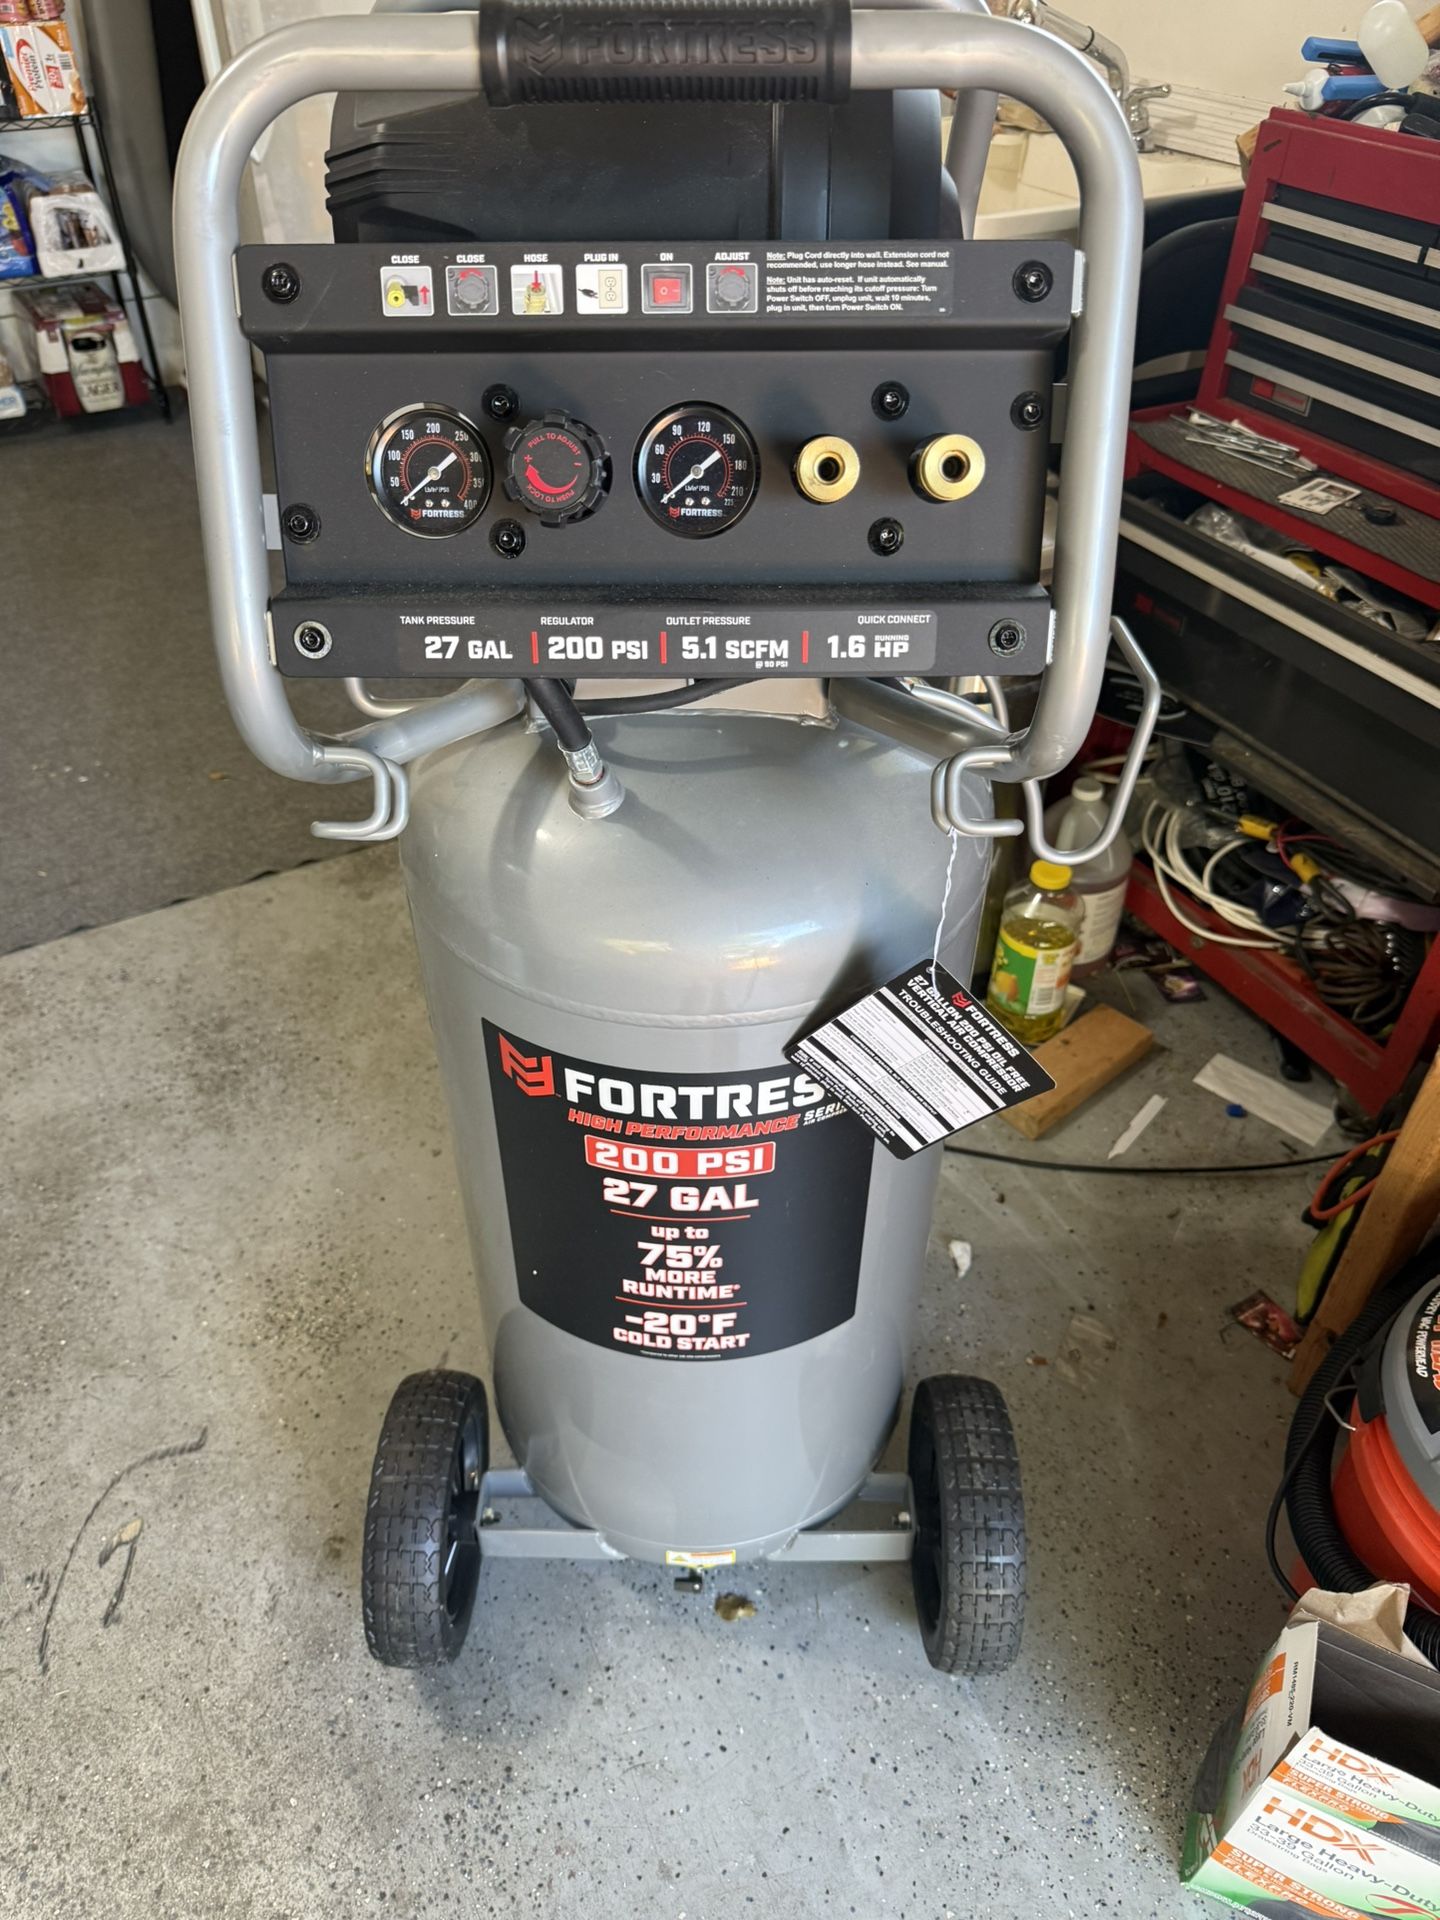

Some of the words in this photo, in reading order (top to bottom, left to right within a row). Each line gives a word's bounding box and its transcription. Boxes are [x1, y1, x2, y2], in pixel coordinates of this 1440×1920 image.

[572, 20, 816, 65] FORTRESS
[20, 51, 37, 92] Premier
[29, 55, 44, 89] Protein
[390, 255, 420, 264] CLOSE
[456, 254, 485, 263] CLOSE
[524, 254, 548, 262] HOSE
[584, 253, 607, 262] PLUG
[608, 253, 619, 262] IN
[660, 253, 673, 261] ON
[714, 252, 750, 261] ADJUST
[766, 252, 786, 260] Note:
[787, 252, 803, 260] Plug
[823, 252, 849, 260] directly
[766, 261, 818, 269] recommended,
[834, 261, 857, 270] longer
[766, 276, 786, 285] Note:
[879, 275, 926, 283] automatically
[822, 285, 853, 294] reaching
[886, 285, 920, 293] pressure:
[766, 294, 789, 302] Power
[790, 294, 814, 302] Switch
[832, 294, 857, 303] unplug
[858, 294, 874, 302] unit,
[900, 294, 932, 302] minutes,
[766, 304, 782, 313] plug
[792, 304, 808, 312] unit,
[841, 303, 864, 311] Power
[865, 303, 889, 311] Switch
[426, 423, 440, 433] 200
[672, 425, 682, 436] 90
[698, 422, 710, 432] 120
[401, 429, 414, 440] 150
[723, 434, 735, 444] 150
[527, 435, 545, 449] PULL
[546, 433, 557, 441] TO
[556, 435, 581, 456] ADJUST
[655, 444, 664, 454] 60
[388, 450, 400, 460] 100
[735, 460, 747, 470] 180
[390, 477, 399, 487] 50
[651, 473, 660, 483] 30
[526, 483, 544, 501] LOCK
[556, 489, 576, 502] PUSH
[731, 486, 744, 496] 210
[545, 495, 556, 503] TO
[422, 510, 464, 518] FORTRESS
[680, 508, 722, 517] FORTRESS
[400, 616, 425, 625] TANK
[427, 616, 475, 625] PRESSURE
[540, 617, 594, 626] REGULATOR
[666, 616, 701, 625] OUTLET
[702, 616, 751, 625] PRESSURE
[857, 615, 886, 625] QUICK
[887, 614, 931, 624] CONNECT
[424, 635, 460, 659] 27
[467, 640, 513, 660] GAL
[548, 635, 604, 660] 200
[611, 640, 648, 659] PSI
[682, 635, 717, 659] 5.1
[725, 640, 789, 659] SCFM
[827, 635, 866, 658] 1.6
[873, 641, 909, 658] HP
[905, 978, 950, 1020] VERTICAL
[945, 1018, 966, 1036] AIR
[961, 1034, 1023, 1092] COMPRESSOR
[913, 974, 928, 986] 27
[924, 985, 962, 1020] GALLON
[958, 1018, 979, 1037] 200
[975, 1036, 994, 1052] PSI
[990, 1051, 1009, 1067] OIL
[1004, 1065, 1031, 1088] FREE
[965, 1005, 1020, 1057] FORTRESS
[896, 988, 981, 1069] TROUBLESHOOTING
[976, 1067, 1008, 1095] GUIDE
[564, 1067, 828, 1120] FORTRES
[567, 1108, 621, 1135] HIGH
[625, 1113, 801, 1141] PERFORMANCE
[804, 1101, 844, 1121] SERI
[595, 1142, 679, 1175] 200
[697, 1147, 764, 1175] PSI
[603, 1177, 658, 1207] 27
[670, 1184, 759, 1211] GAL
[651, 1226, 680, 1240] up
[684, 1226, 709, 1239] to
[637, 1241, 723, 1269] 75%
[645, 1268, 716, 1284] MORE
[1420, 1315, 1433, 1330] VAC
[613, 1327, 672, 1349] COLD
[676, 1333, 750, 1350] START
[1415, 1330, 1429, 1378] POWERHEAD
[1309, 1738, 1401, 1786] HDX
[1297, 1759, 1334, 1779] 33-39
[1337, 1777, 1377, 1799] Gallon
[1289, 1768, 1333, 1796] SUPER
[1335, 1790, 1390, 1820] STRONG
[1303, 1753, 1347, 1776] Large
[1350, 1774, 1440, 1822] Heavy-Duty
[1263, 1796, 1386, 1866] HDX
[1246, 1828, 1300, 1860] Drawstring
[1302, 1857, 1329, 1875] Bags
[1249, 1822, 1299, 1852] 33-39
[1301, 1849, 1356, 1881] Gallon
[1254, 1815, 1314, 1850] Large
[1319, 1848, 1440, 1913] Heavy-Duty
[1230, 1848, 1287, 1883] SUPER
[1289, 1881, 1362, 1920] STRONG
